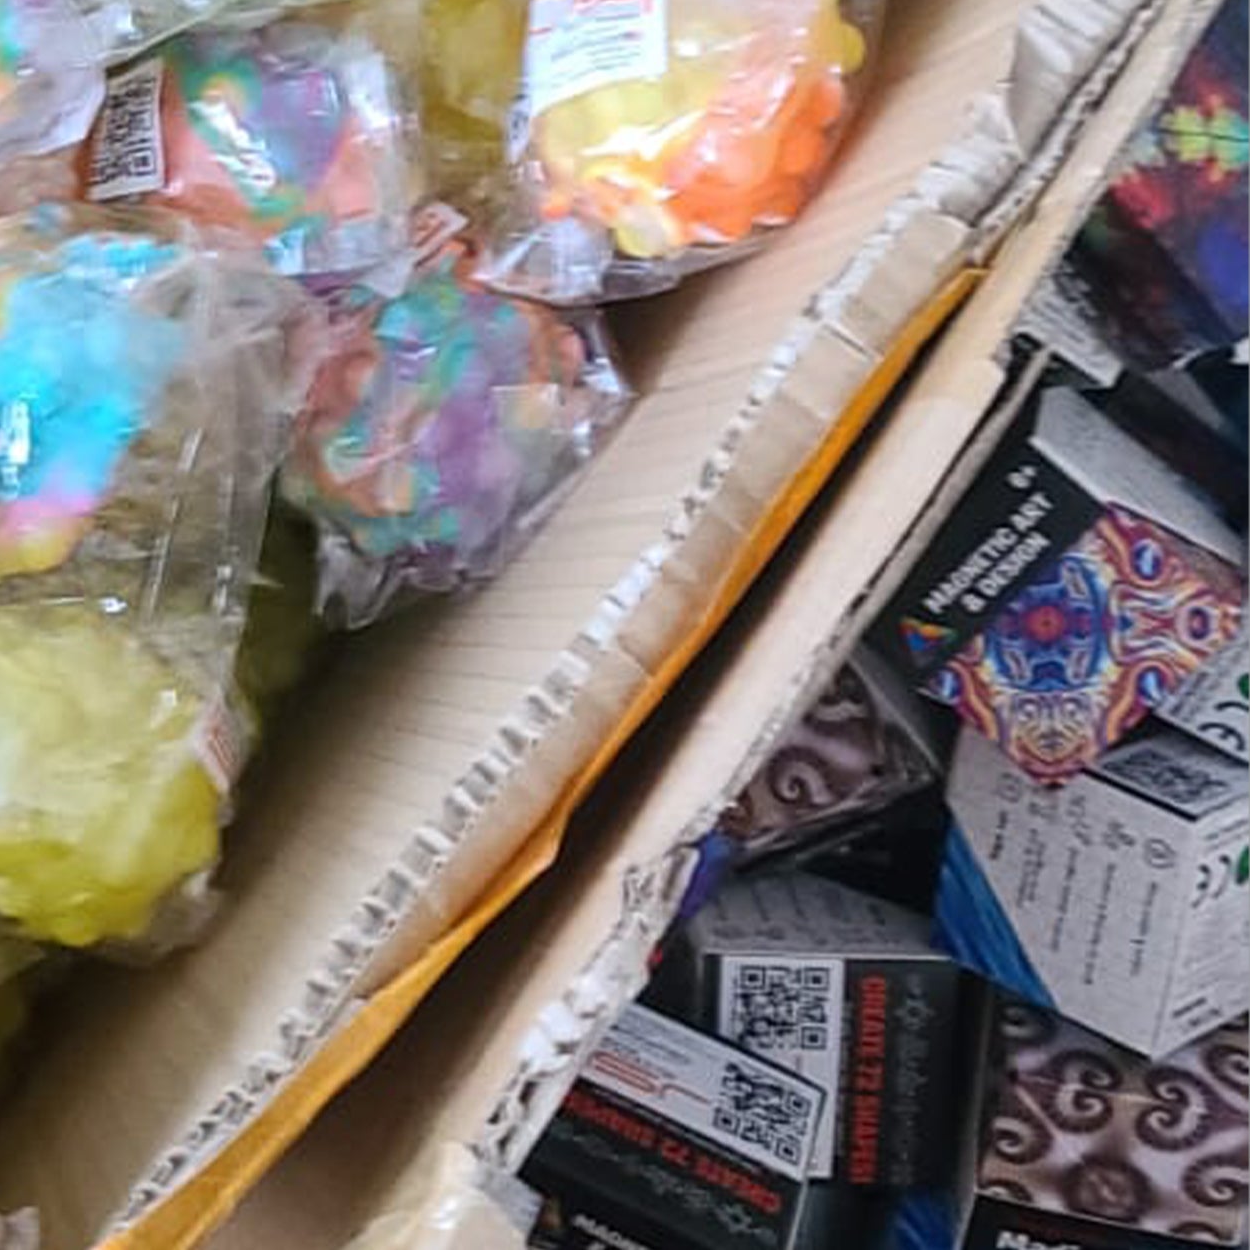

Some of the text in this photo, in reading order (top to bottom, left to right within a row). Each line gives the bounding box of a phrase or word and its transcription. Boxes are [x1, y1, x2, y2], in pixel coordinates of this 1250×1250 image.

[923, 492, 1053, 614] MAGNETIC ART
[960, 531, 1051, 613] & DESIGN
[860, 975, 886, 1057] CREATE
[856, 1062, 884, 1090] 72
